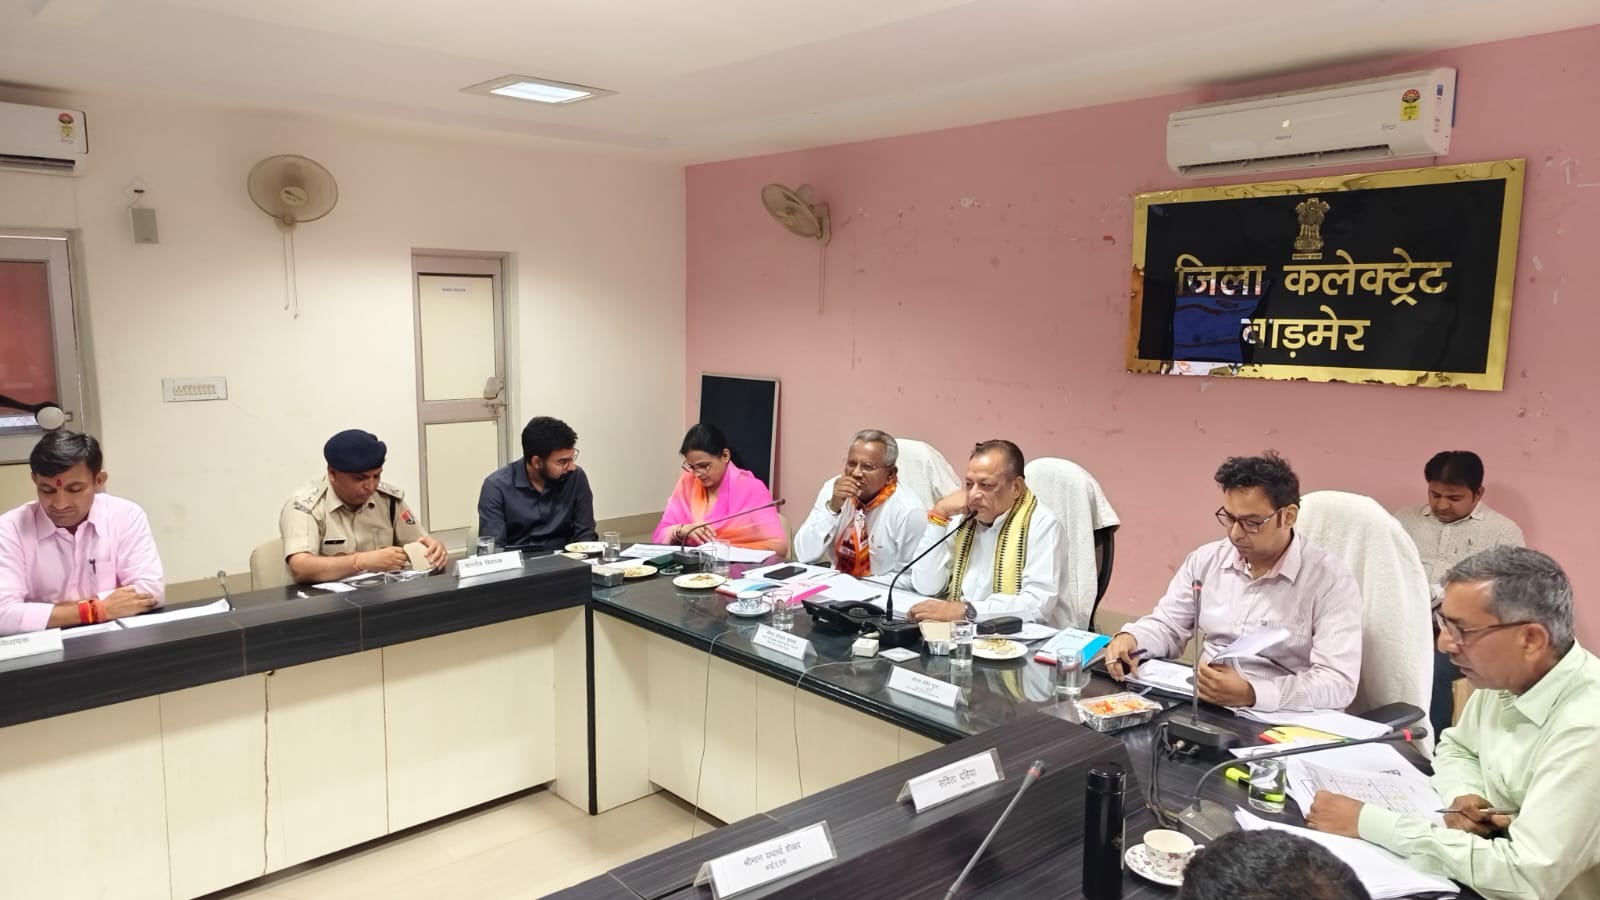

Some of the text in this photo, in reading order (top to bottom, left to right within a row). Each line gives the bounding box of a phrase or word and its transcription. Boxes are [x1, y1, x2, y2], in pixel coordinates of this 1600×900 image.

[1175, 247, 1452, 306] जिला कलेक्ट्रेट
[1241, 304, 1371, 358] बाड़मेर
